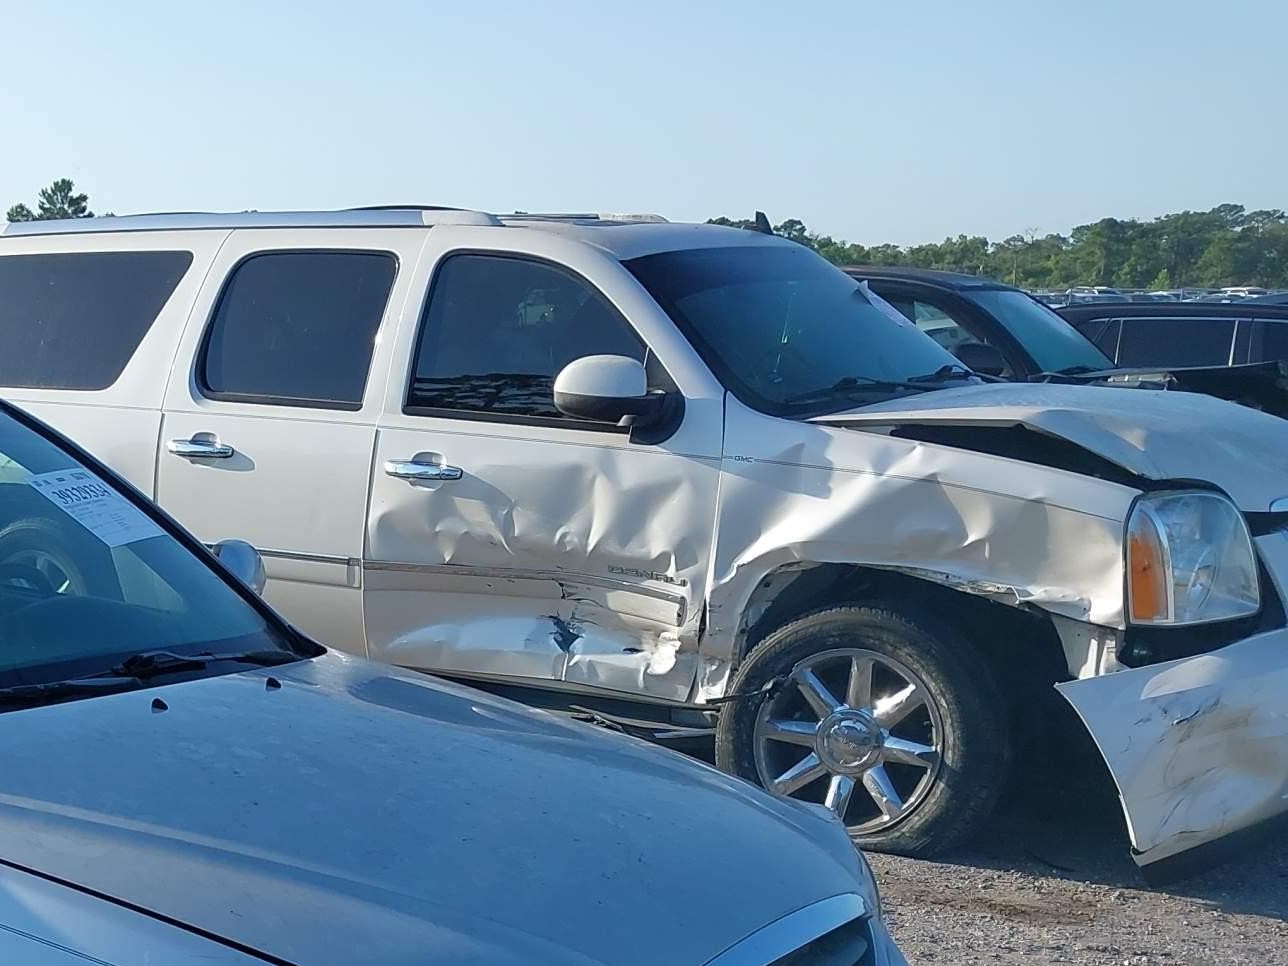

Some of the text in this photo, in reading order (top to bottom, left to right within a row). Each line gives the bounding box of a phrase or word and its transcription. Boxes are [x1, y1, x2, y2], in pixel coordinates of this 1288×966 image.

[734, 455, 754, 463] GMC
[51, 482, 112, 505] 39329334
[608, 565, 688, 587] DENALI
